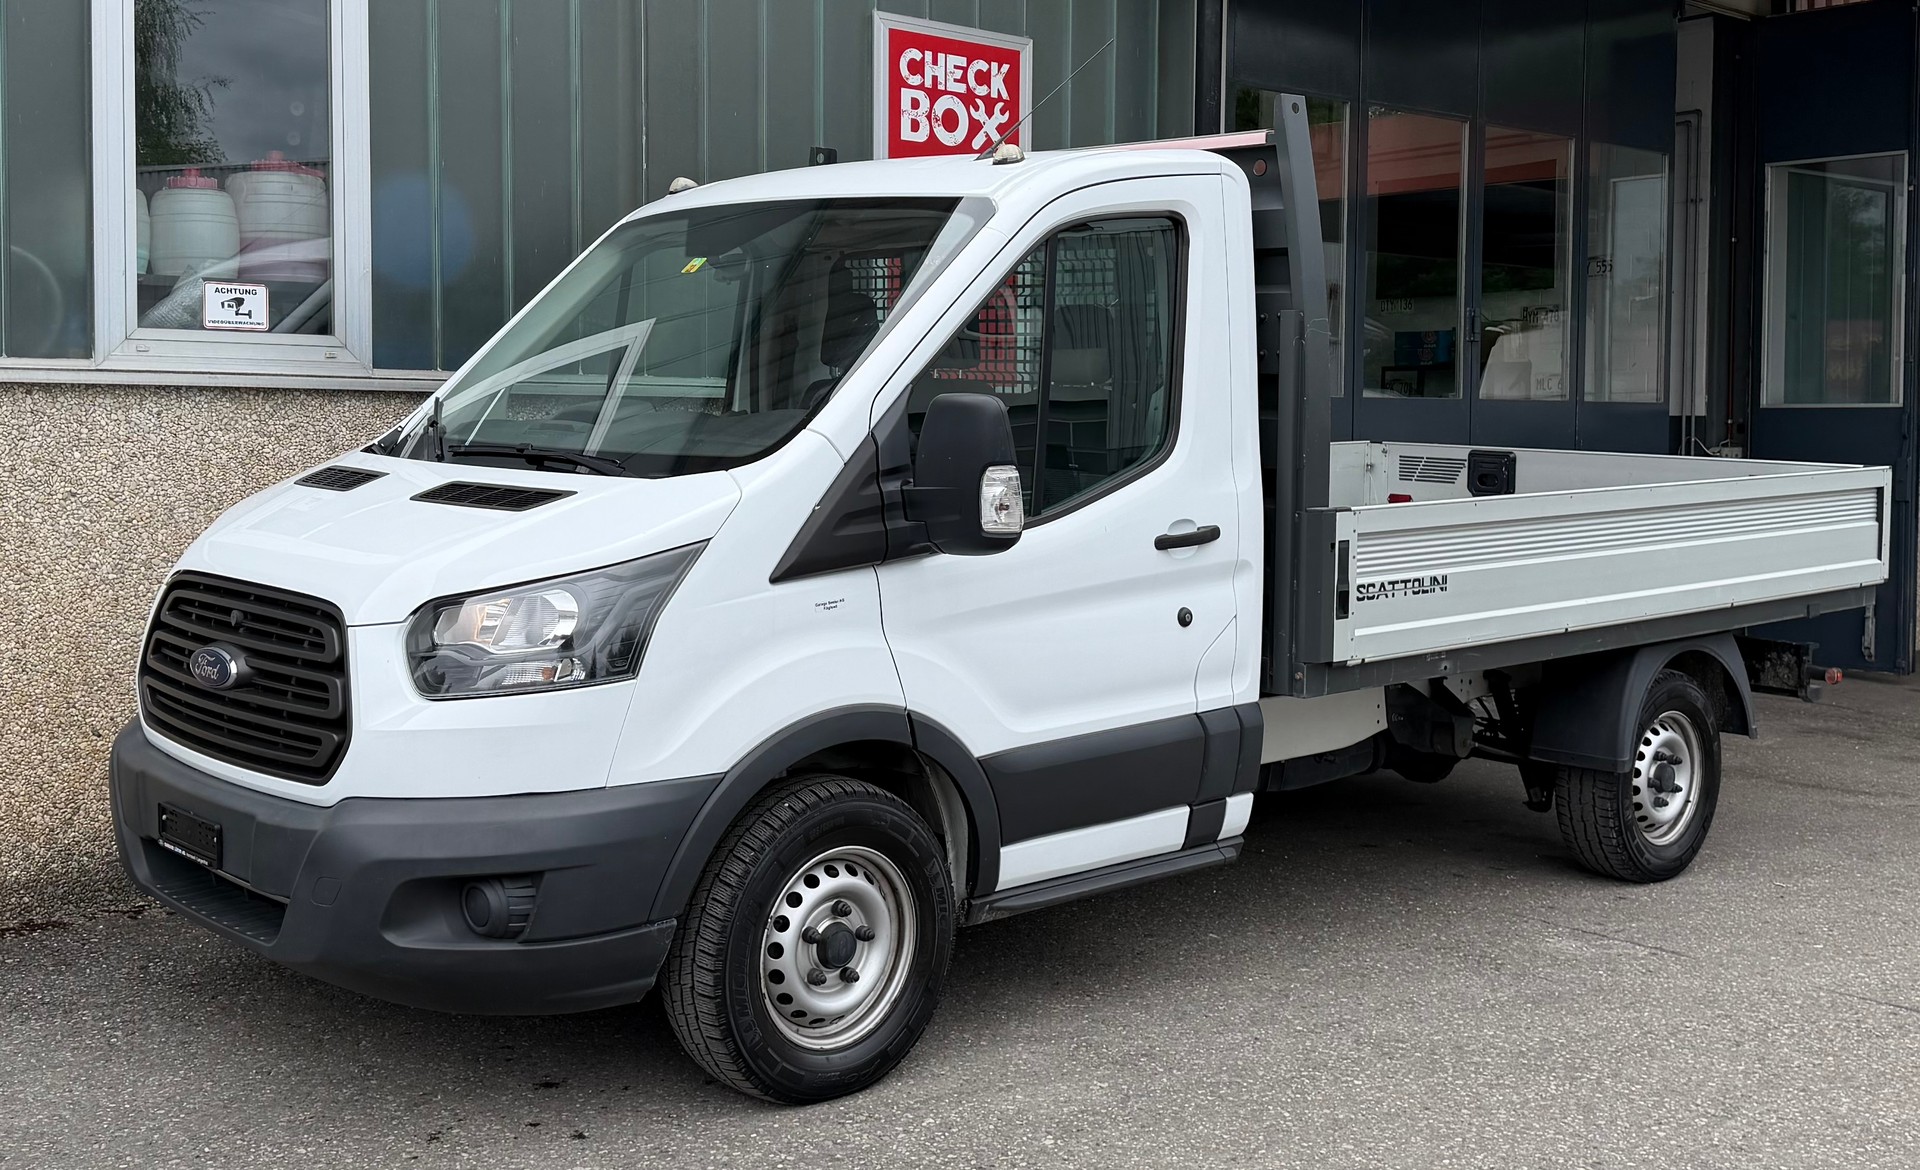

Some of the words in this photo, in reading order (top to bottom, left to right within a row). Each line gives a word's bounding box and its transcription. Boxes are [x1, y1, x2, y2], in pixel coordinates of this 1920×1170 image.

[899, 47, 1011, 101] CHECK
[214, 286, 258, 296] ACHTUNG
[1356, 574, 1448, 602] SCATTOLINI
[195, 653, 221, 680] Ford
